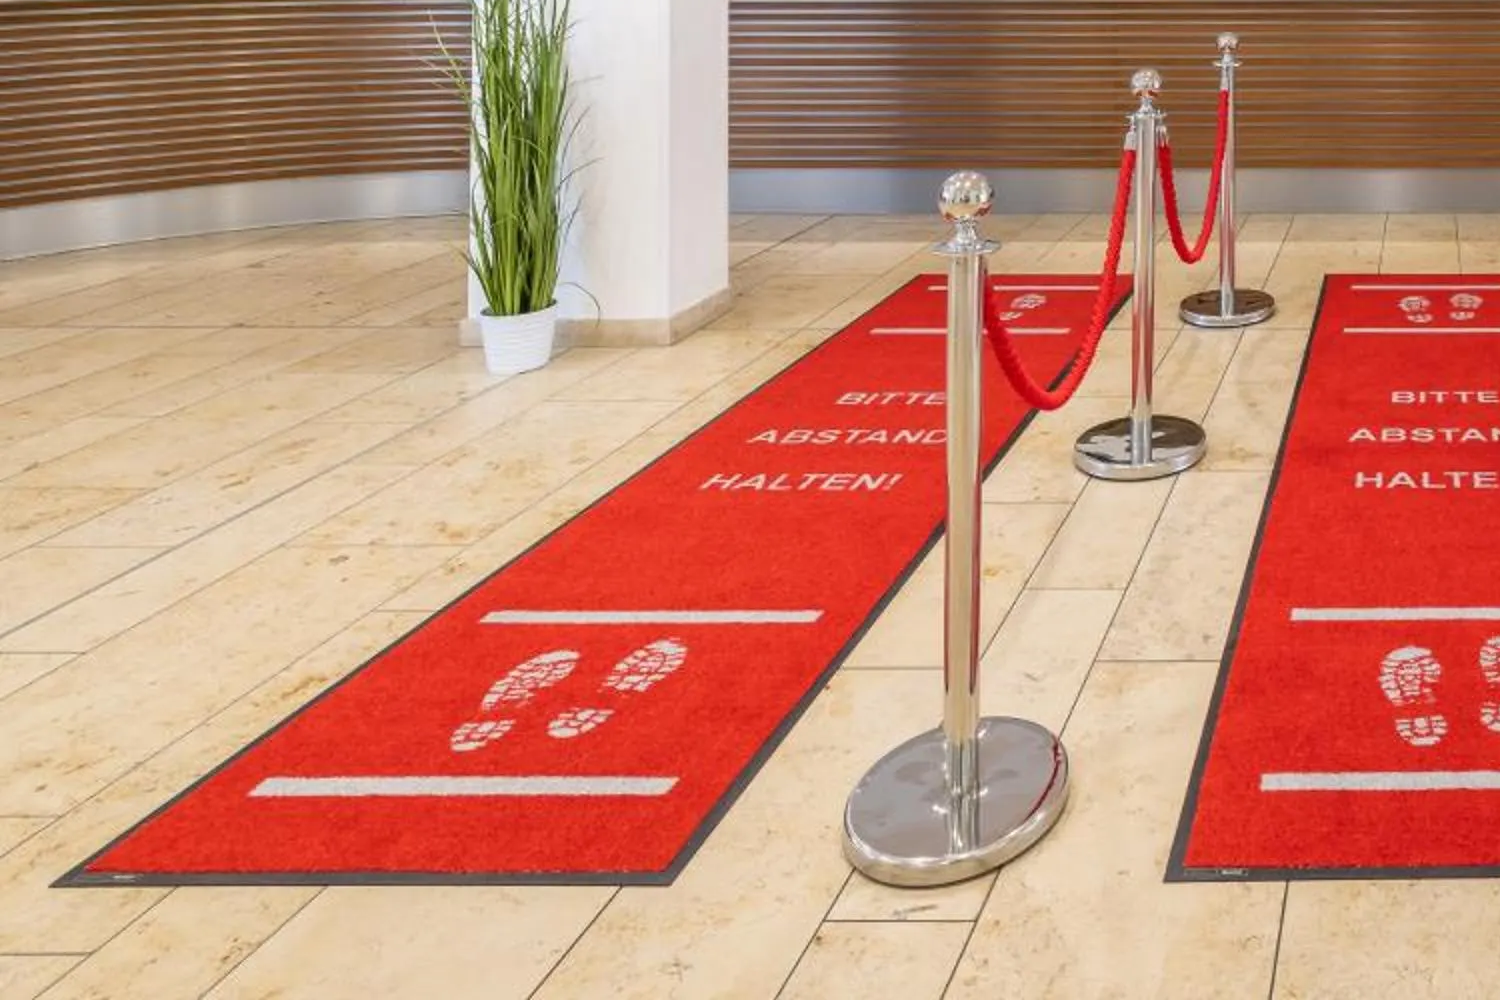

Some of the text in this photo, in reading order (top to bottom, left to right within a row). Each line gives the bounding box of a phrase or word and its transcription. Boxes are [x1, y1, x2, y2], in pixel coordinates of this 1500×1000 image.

[835, 391, 946, 405] BITTE
[1391, 391, 1499, 404] BITTE
[746, 429, 947, 444] ABSTAND
[701, 473, 903, 491] HALTEN!
